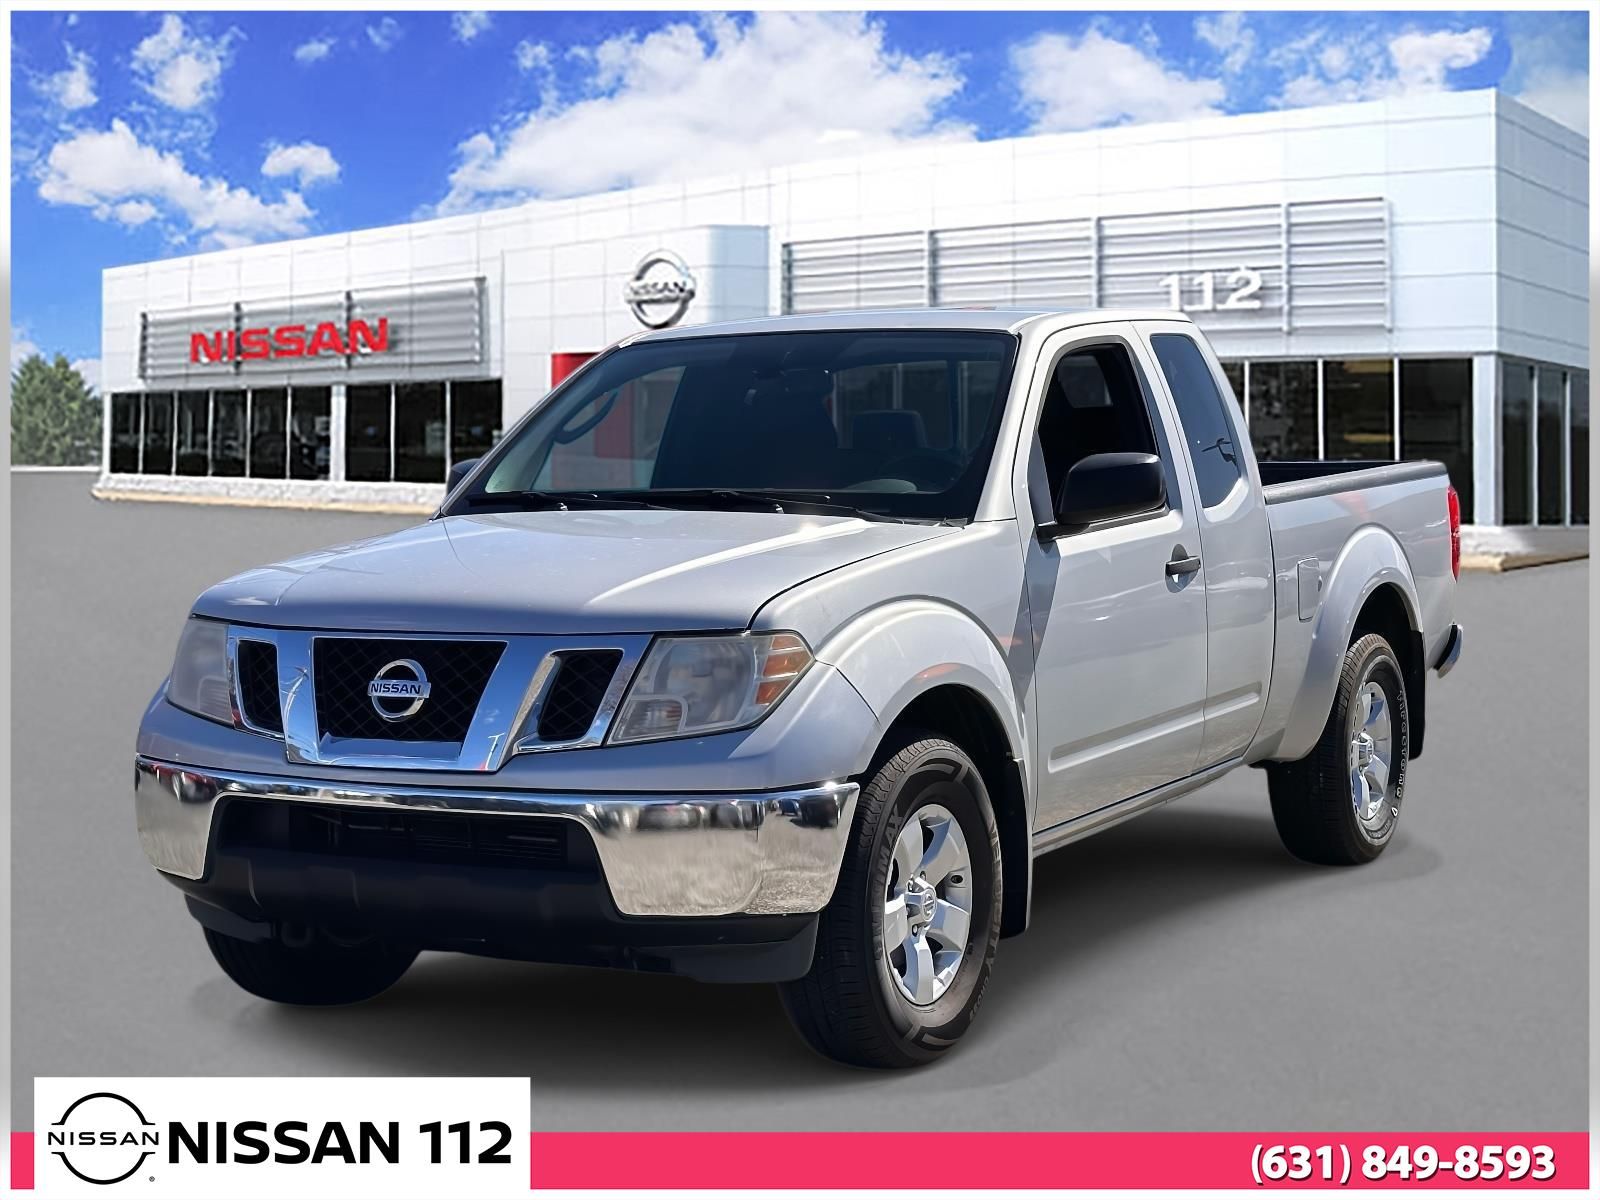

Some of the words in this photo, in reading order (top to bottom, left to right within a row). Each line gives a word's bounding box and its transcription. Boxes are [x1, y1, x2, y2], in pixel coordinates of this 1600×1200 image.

[1159, 268, 1262, 311] 112
[190, 317, 389, 364] NISSAN
[370, 683, 421, 695] NISSAN
